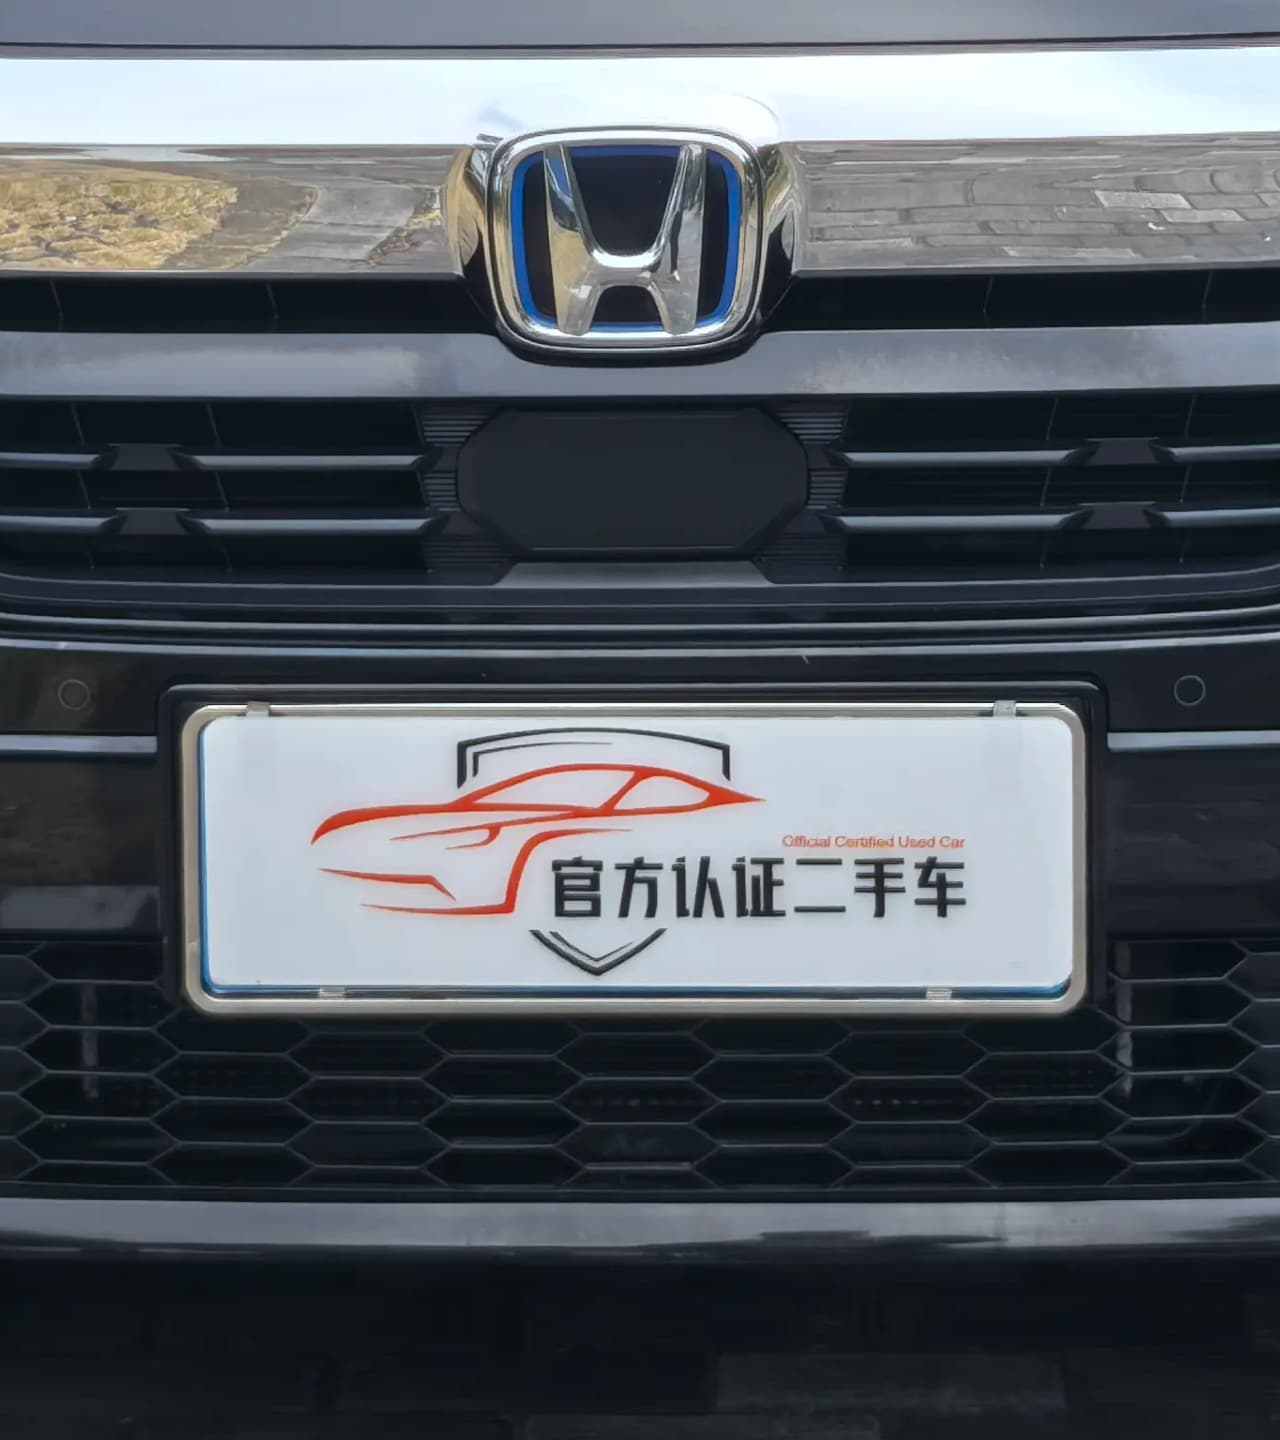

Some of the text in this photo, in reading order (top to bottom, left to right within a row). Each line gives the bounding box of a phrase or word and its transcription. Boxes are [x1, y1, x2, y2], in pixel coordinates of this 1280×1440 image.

[782, 835, 966, 848] Official Certified Used Car
[551, 856, 967, 918] 官方认证二手车
